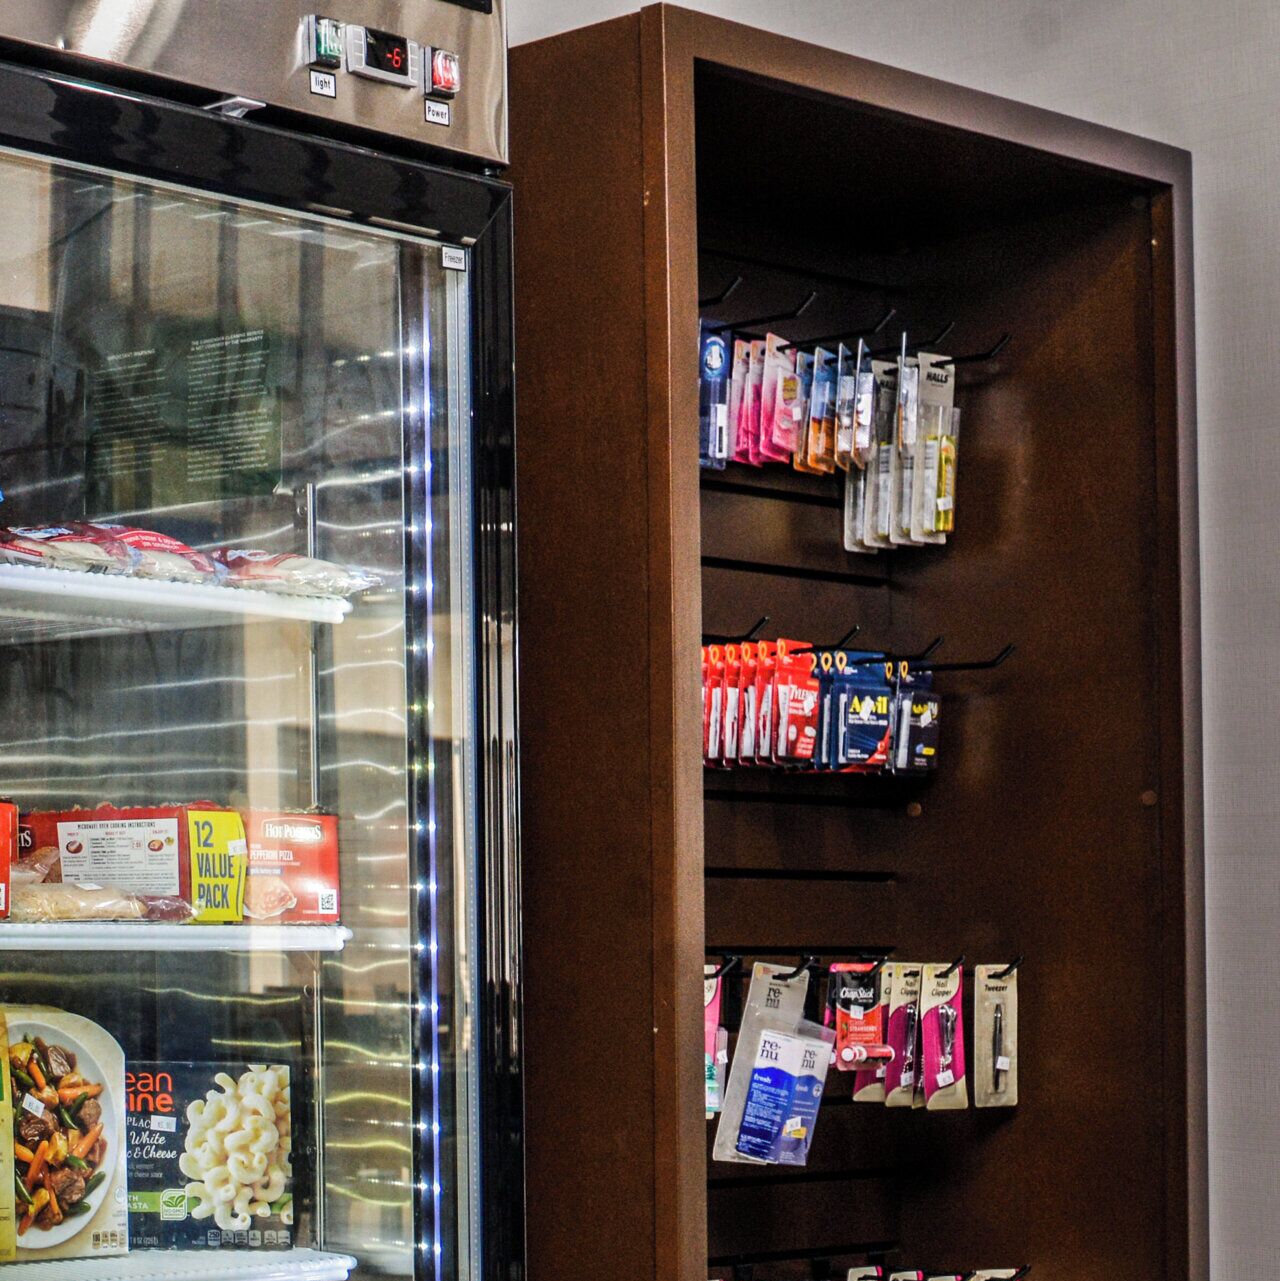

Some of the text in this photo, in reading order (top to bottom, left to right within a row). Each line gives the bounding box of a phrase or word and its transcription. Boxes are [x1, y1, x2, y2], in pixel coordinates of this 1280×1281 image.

[386, 48, 402, 69] -6
[314, 75, 332, 91] light
[427, 105, 448, 120] Power
[926, 371, 949, 385] HALLS
[127, 821, 156, 829] INSTRUCTIONS
[265, 823, 282, 838] HOT
[193, 820, 214, 849] 12
[278, 850, 294, 862] PIZZA
[196, 853, 235, 881] VALUE
[197, 882, 230, 911] PACK
[935, 980, 949, 990] Nail
[984, 984, 1008, 993] Tweezer
[840, 987, 874, 999] ChapStick
[931, 988, 952, 998] Clipper
[760, 1050, 778, 1062] nu
[801, 1058, 815, 1069] nu
[129, 1130, 167, 1146] White
[133, 1144, 178, 1160] & Cheese
